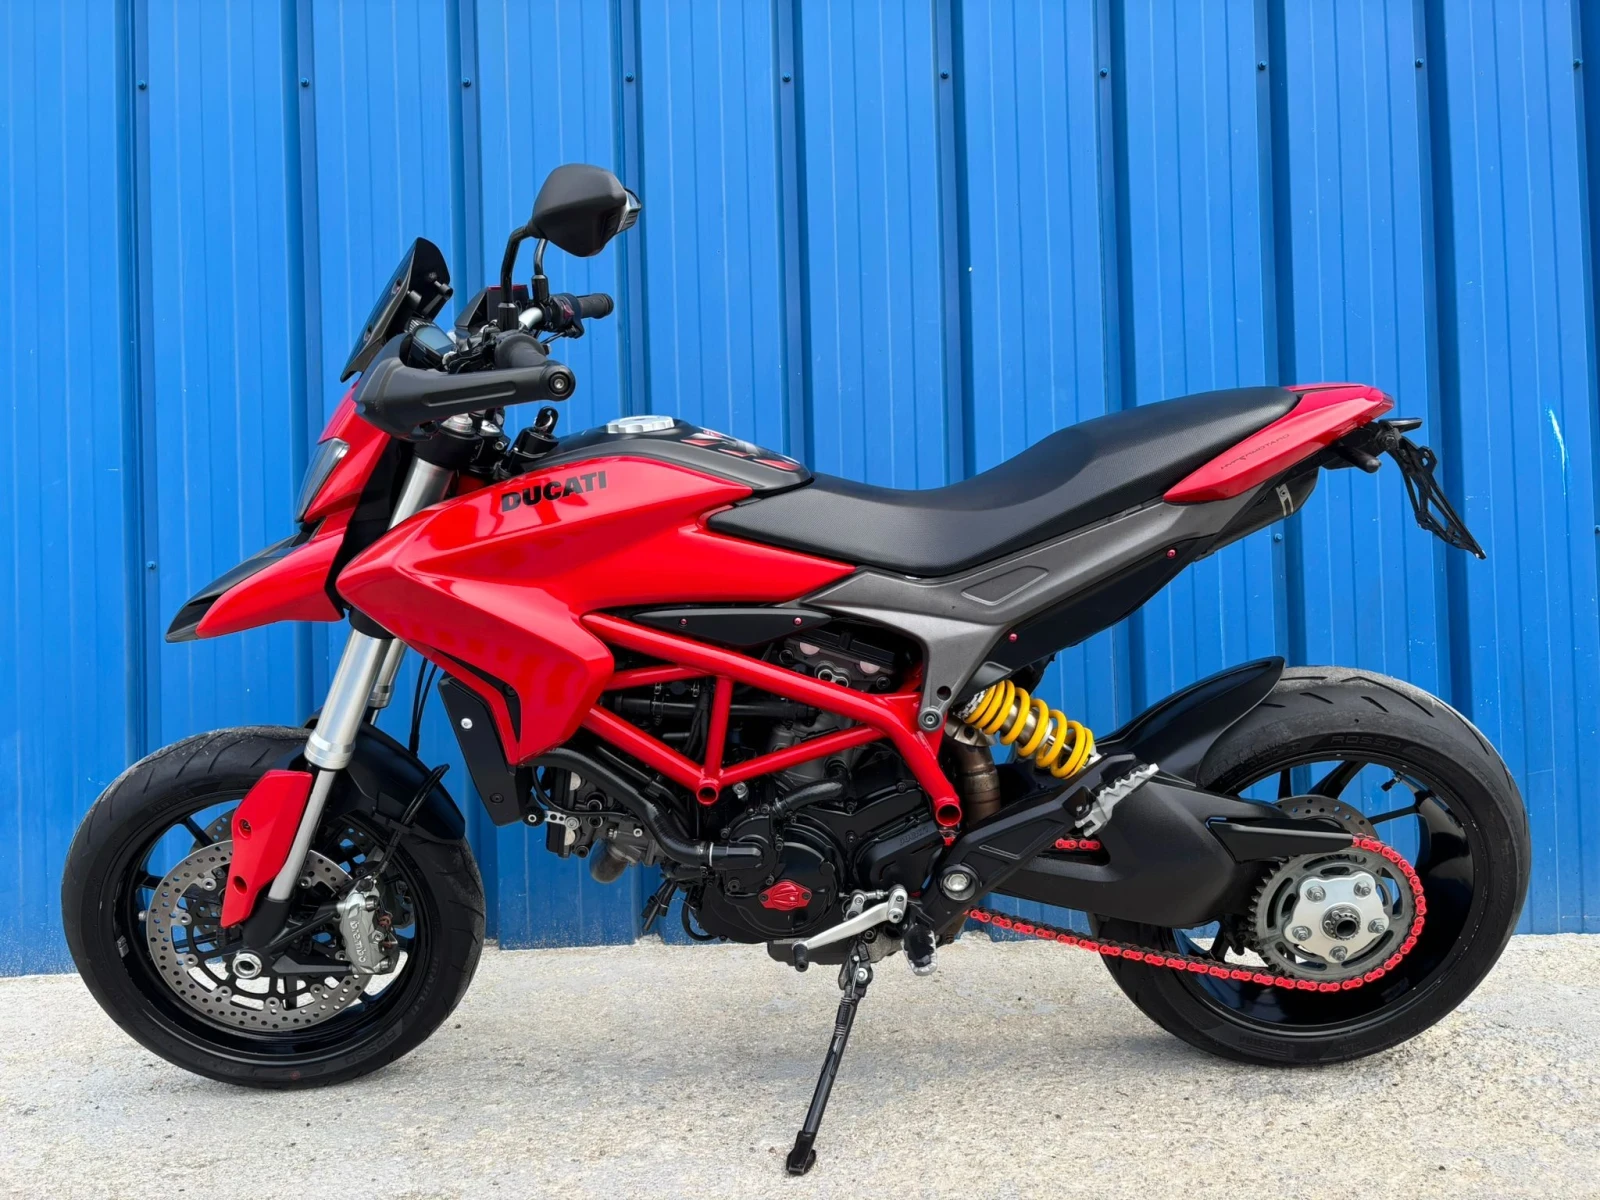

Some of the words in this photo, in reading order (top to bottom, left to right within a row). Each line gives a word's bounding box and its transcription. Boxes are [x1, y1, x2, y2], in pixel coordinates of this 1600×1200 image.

[501, 470, 607, 512] DUCATI
[1330, 735, 1402, 749] ROSSO
[349, 920, 367, 963] brembo
